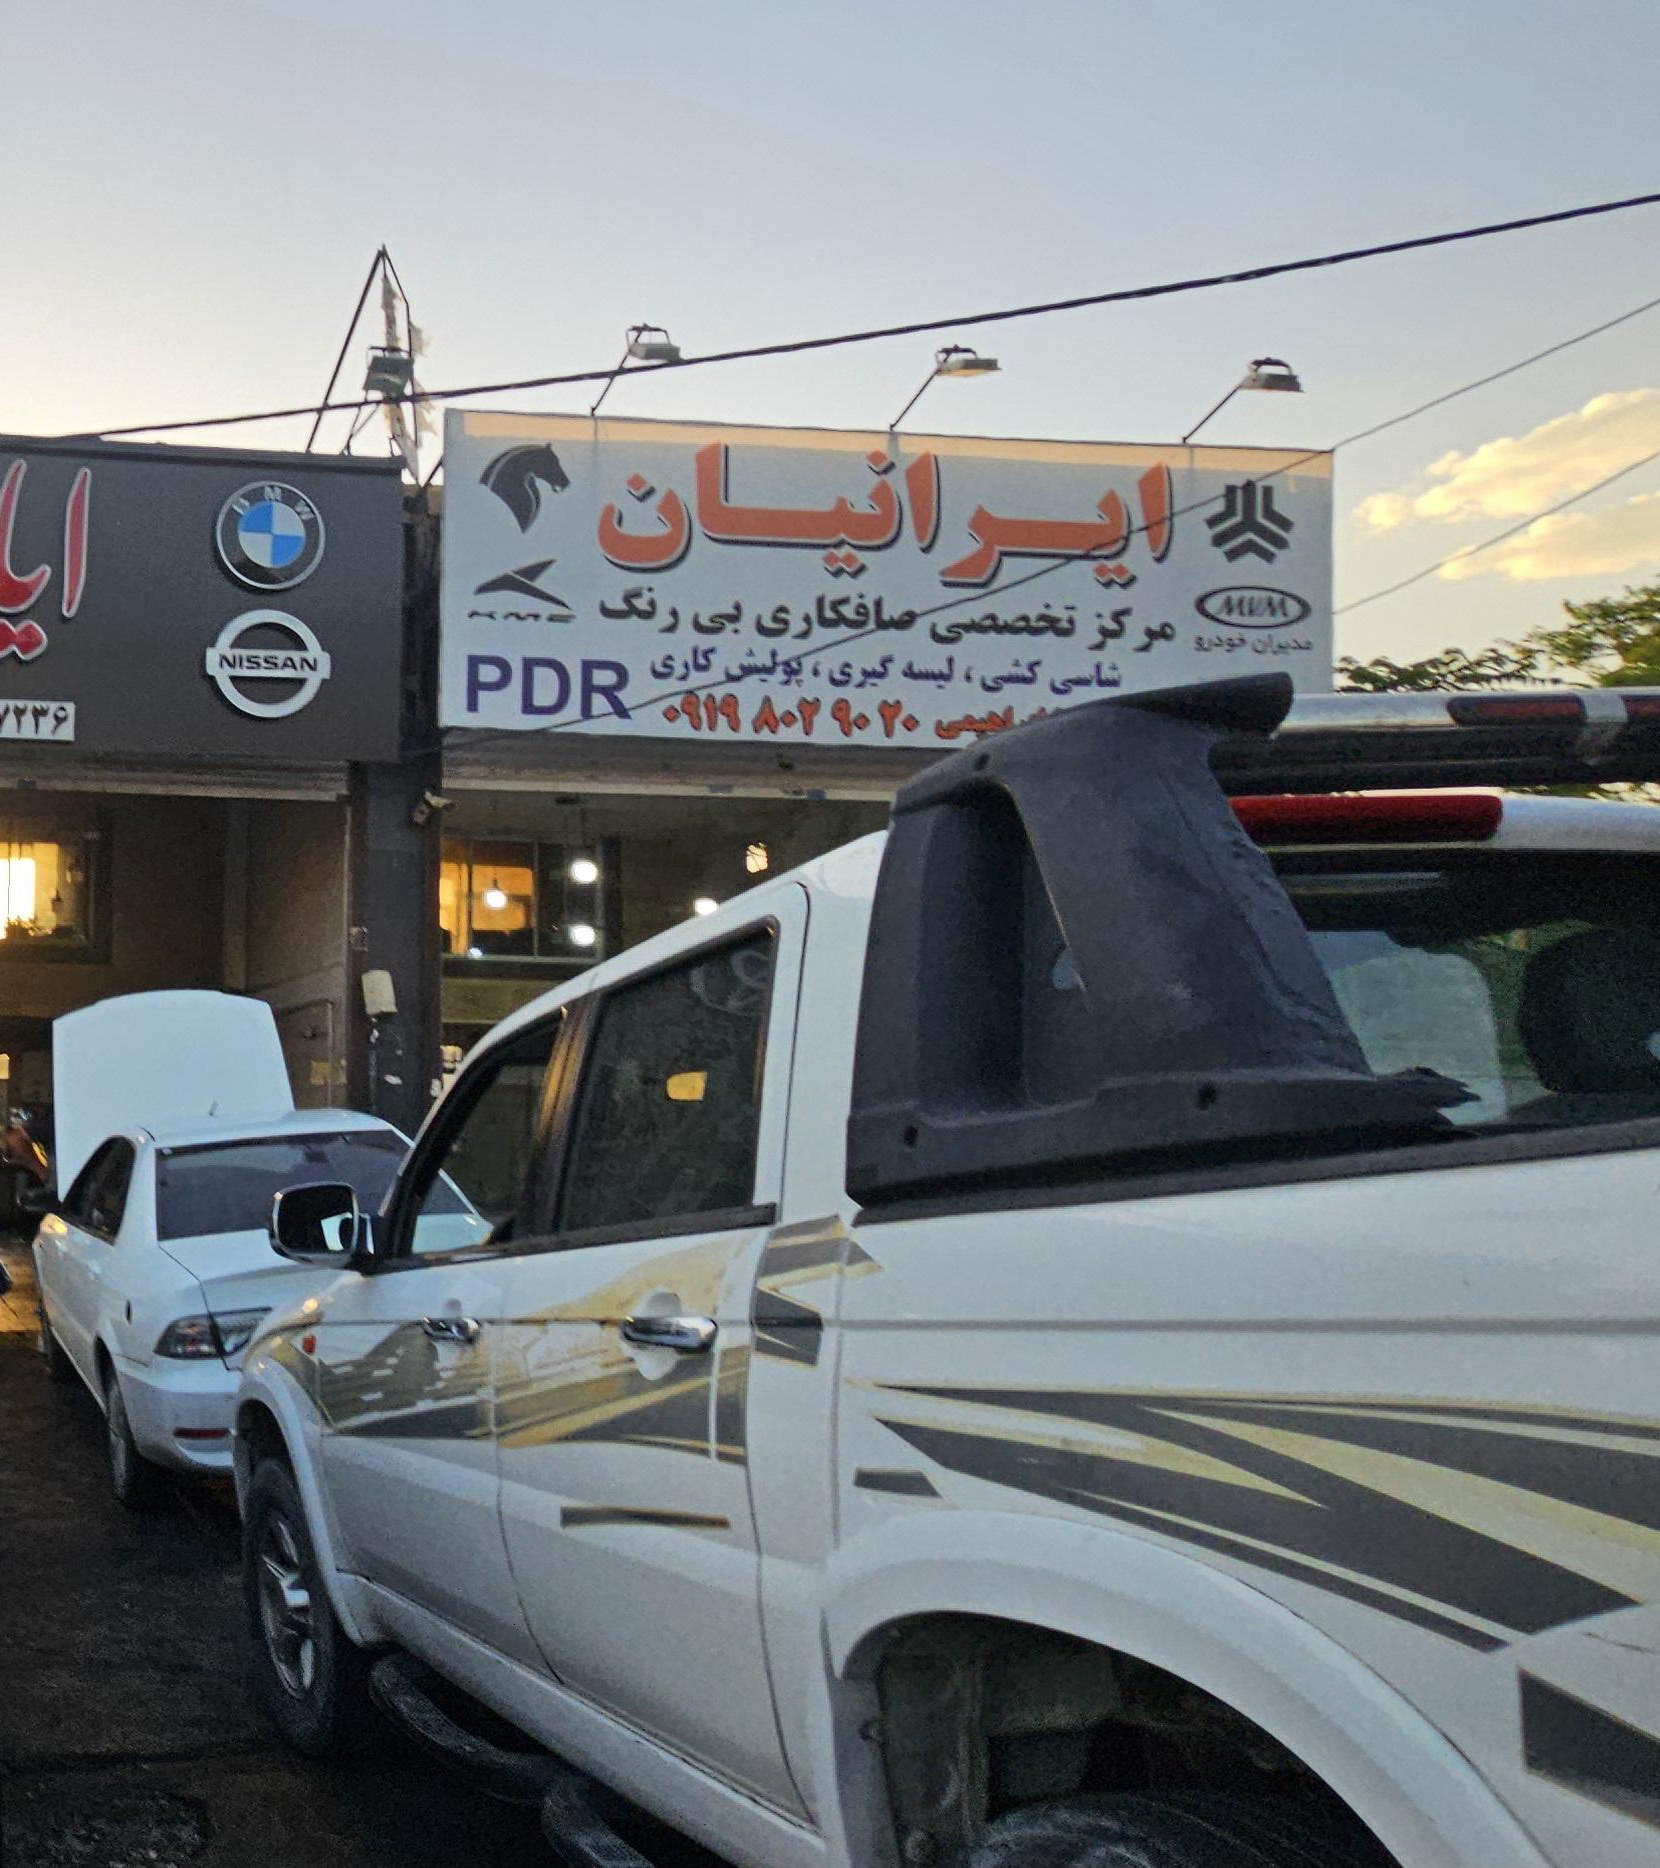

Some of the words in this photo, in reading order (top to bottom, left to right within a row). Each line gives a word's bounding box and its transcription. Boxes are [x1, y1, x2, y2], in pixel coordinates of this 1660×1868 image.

[598, 440, 1172, 587] ایرانیان
[598, 585, 681, 633] رنگ
[692, 600, 743, 635] بی
[754, 592, 918, 639] صافکاری
[929, 602, 1077, 644] تخصصی
[1088, 606, 1177, 652] مرکز
[1194, 632, 1248, 653] خودرو
[1251, 634, 1313, 655] مدیران
[219, 652, 318, 672] NISSAN
[650, 644, 716, 682] کاری
[724, 648, 804, 687] پولیش
[901, 656, 955, 689] لیسه
[1049, 661, 1121, 695] شاسی
[466, 654, 632, 720] PDR
